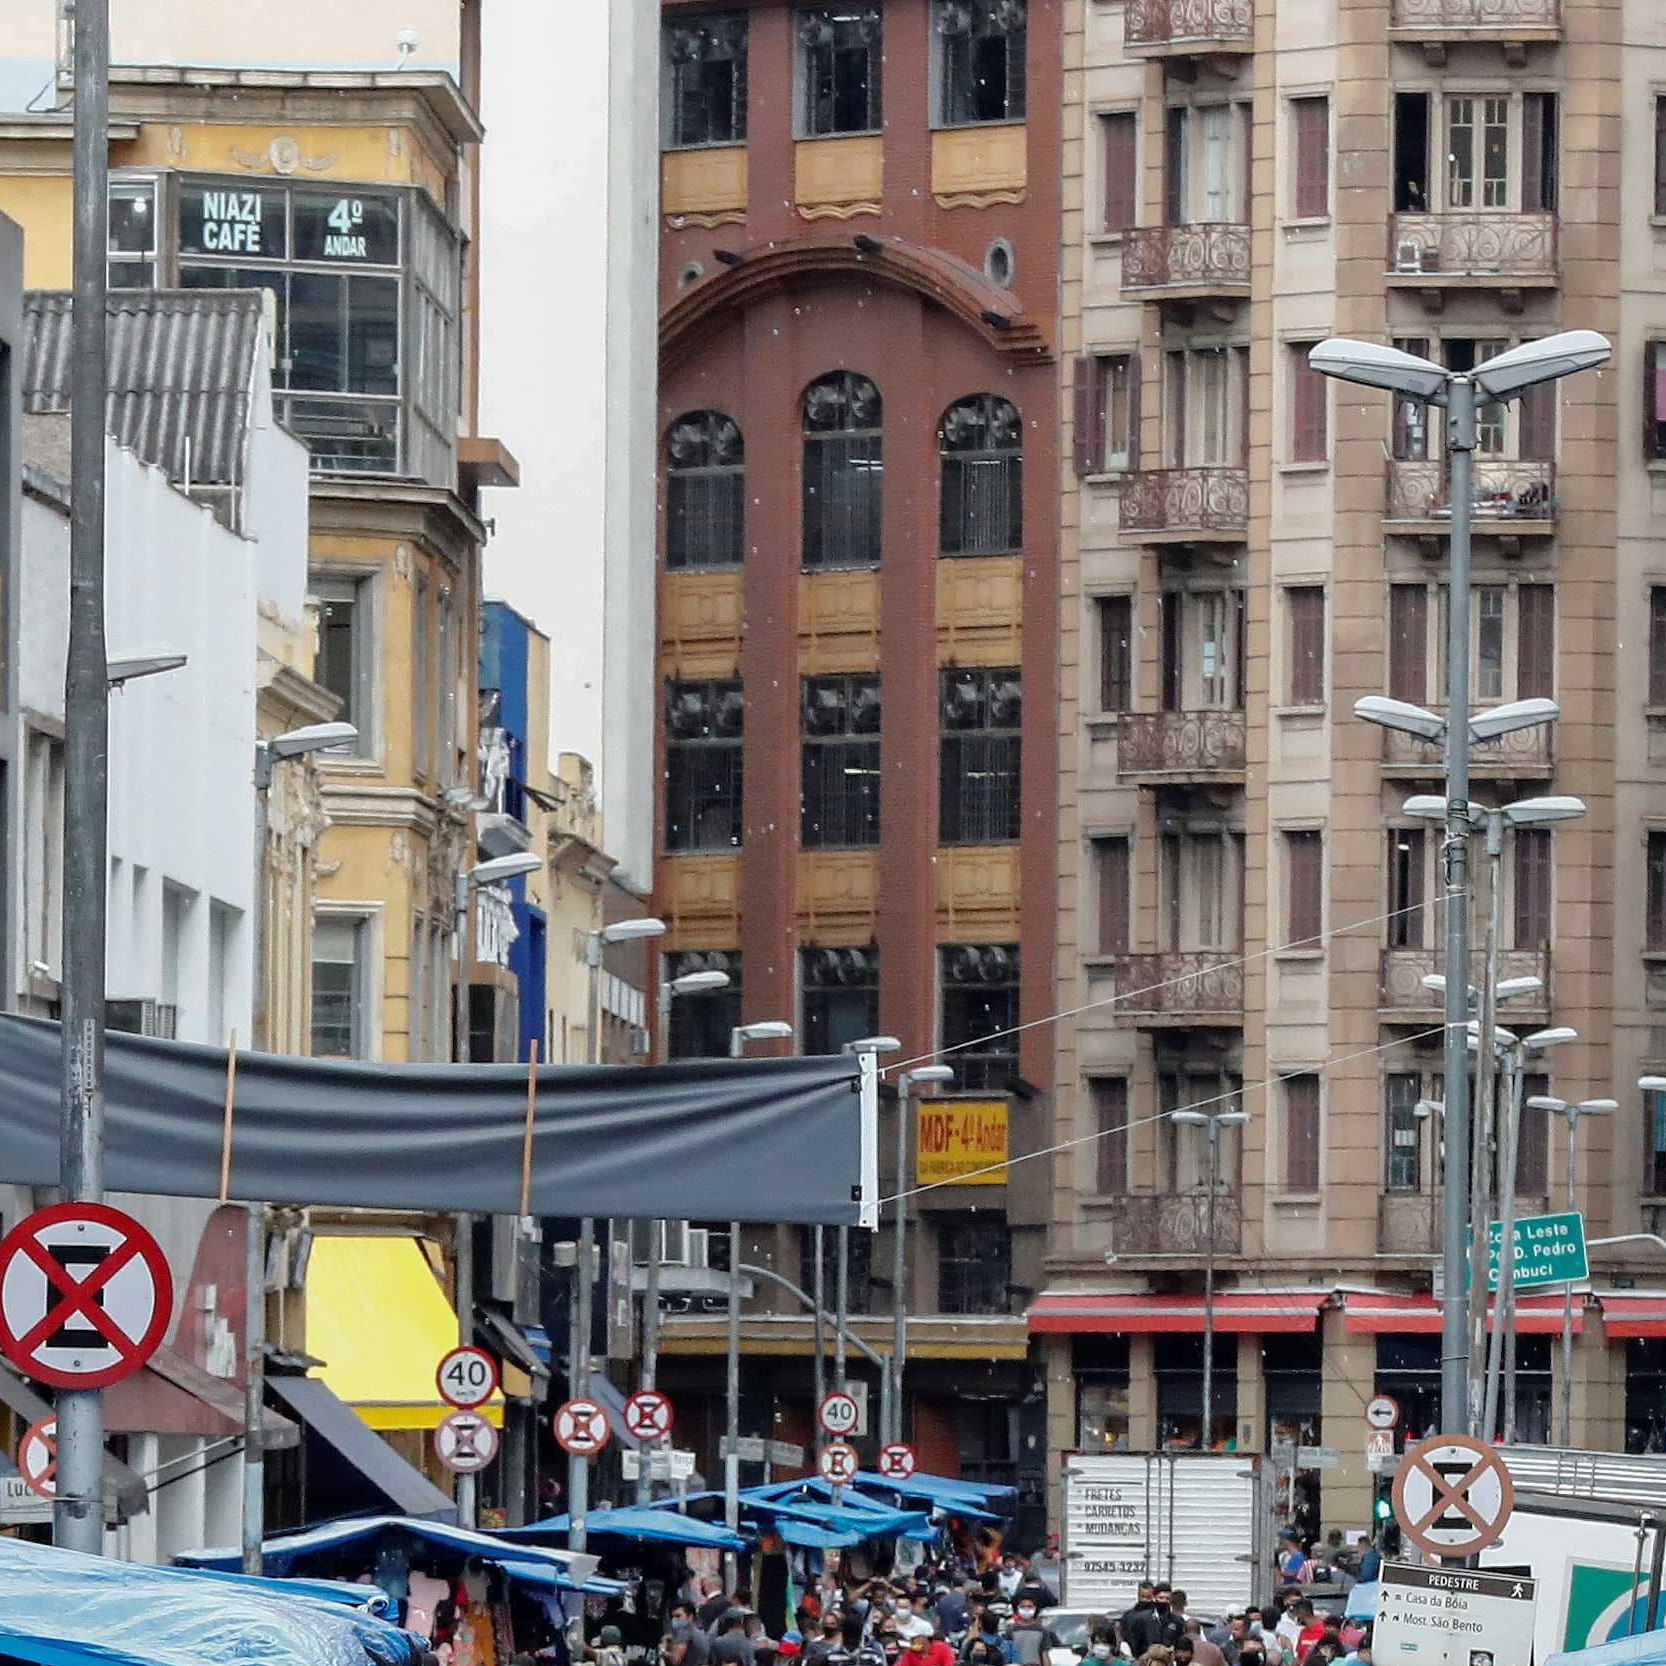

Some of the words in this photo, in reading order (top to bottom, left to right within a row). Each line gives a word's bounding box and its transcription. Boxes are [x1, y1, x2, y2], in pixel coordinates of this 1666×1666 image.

[203, 192, 262, 222] NIAZI
[203, 220, 261, 252] CAFÉ
[323, 235, 366, 257] ANDAR
[1527, 1223, 1568, 1239] Leste
[1533, 1241, 1576, 1257] Pedro
[446, 1361, 486, 1386] 40
[826, 1402, 853, 1420] 40
[1085, 1489, 1122, 1501] FRETES
[1085, 1505, 1136, 1518] CARRETOS
[1086, 1523, 1141, 1536] MUDANÇAS
[1428, 1575, 1479, 1590] PEDESTRE
[1406, 1592, 1427, 1605] Casa
[1430, 1595, 1442, 1607] da
[1445, 1597, 1468, 1610] Bóia
[1431, 1616, 1449, 1629] São
[1452, 1620, 1483, 1633] Bento
